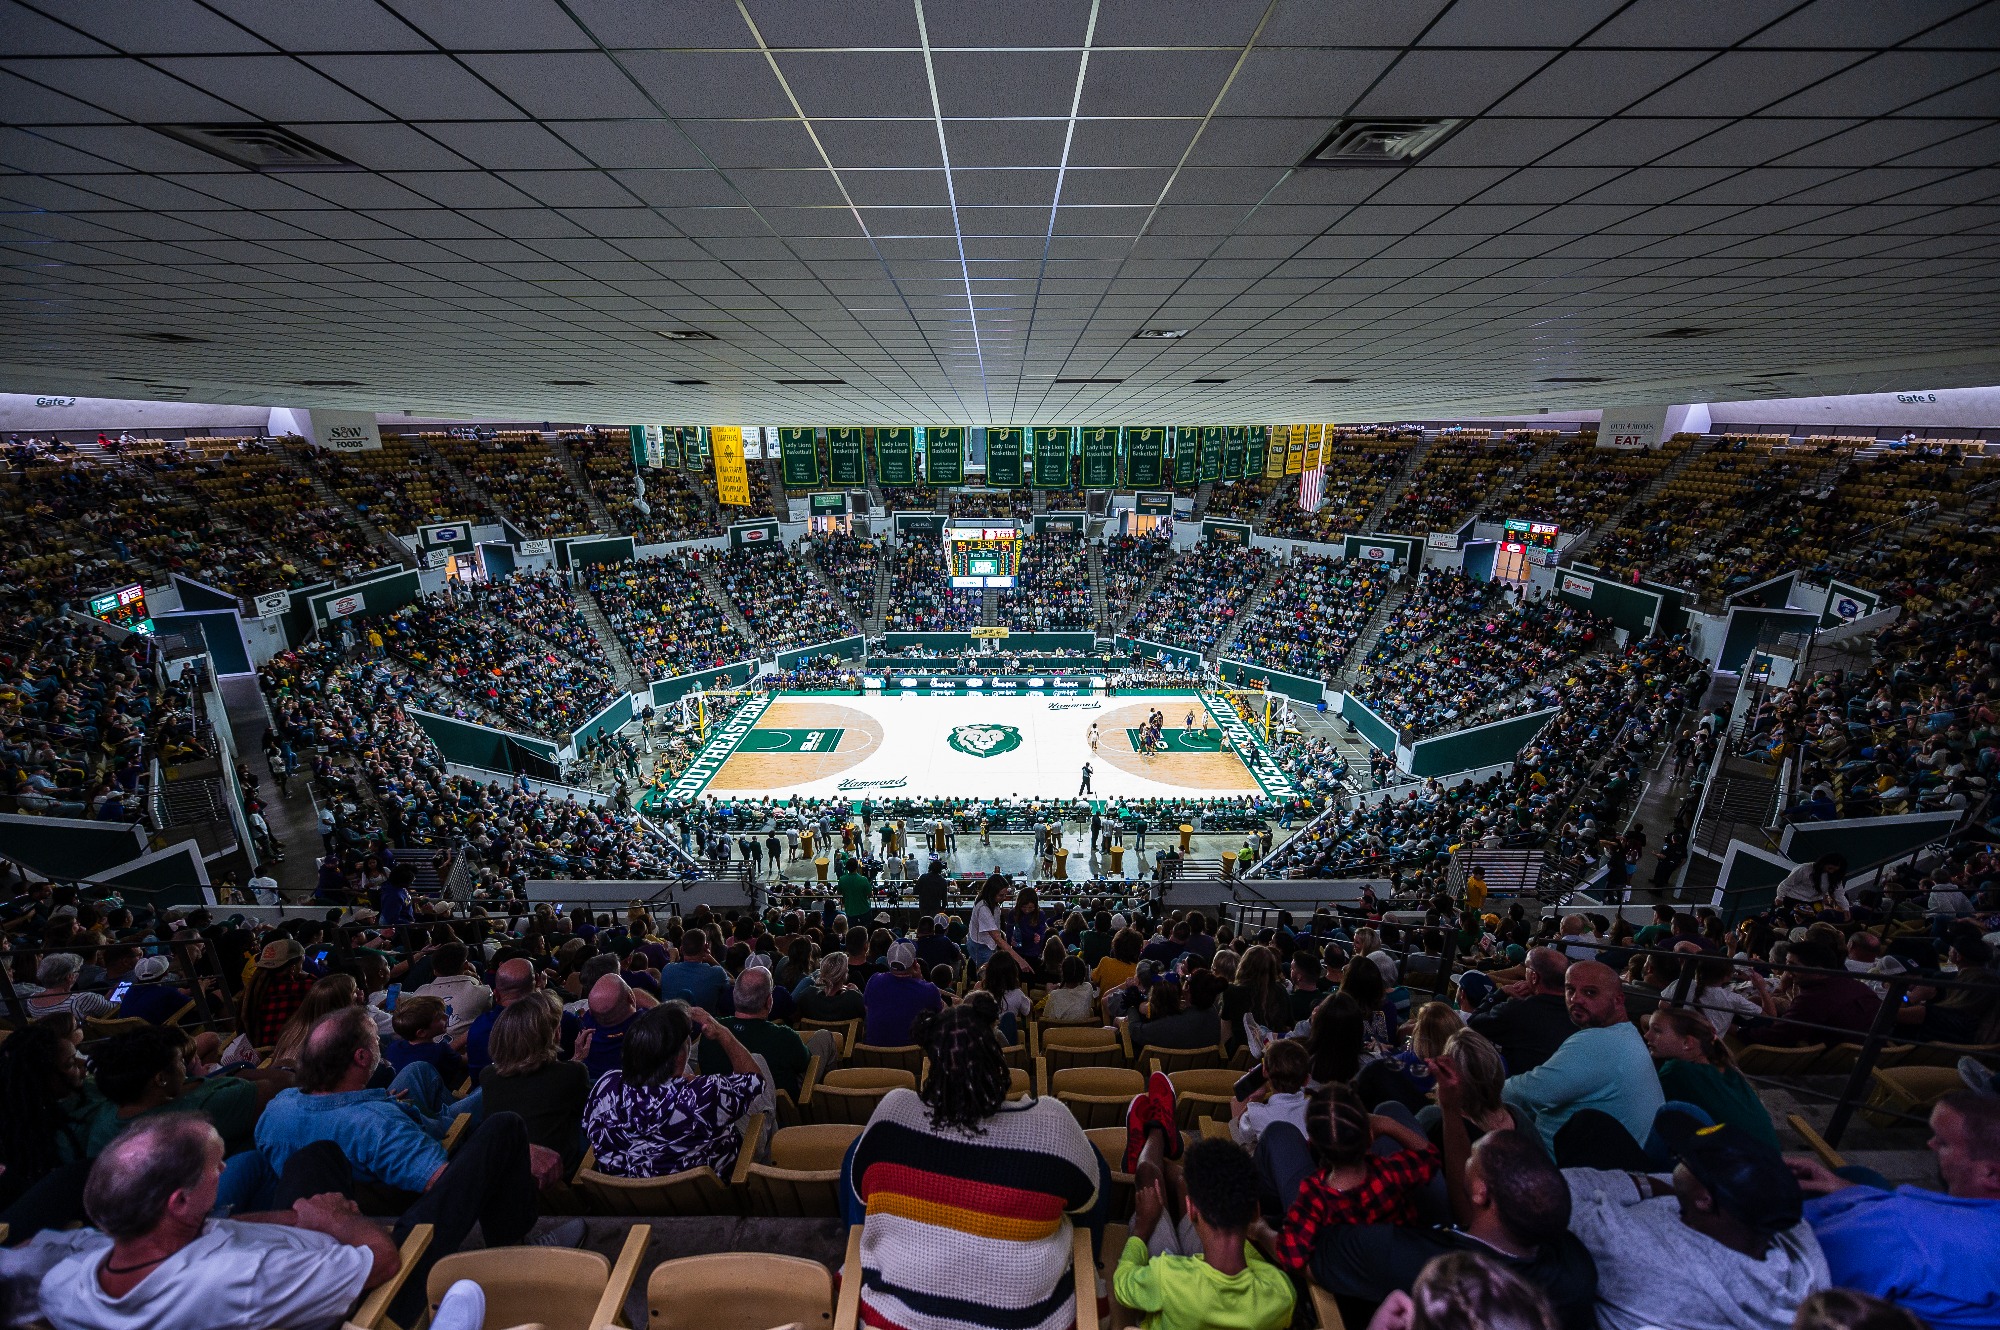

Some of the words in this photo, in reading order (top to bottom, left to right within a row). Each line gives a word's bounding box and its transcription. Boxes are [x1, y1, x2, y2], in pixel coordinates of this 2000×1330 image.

[36, 397, 65, 406] Gate
[68, 397, 76, 406] 2
[1897, 394, 1926, 403] Gate
[1927, 393, 1937, 402] 6
[331, 426, 362, 438] S&W
[1523, 533, 1538, 541] 3:42
[257, 591, 286, 604] RONNIE'S
[667, 696, 771, 800] SOUTHEASTERN
[837, 775, 908, 789] Hammond
